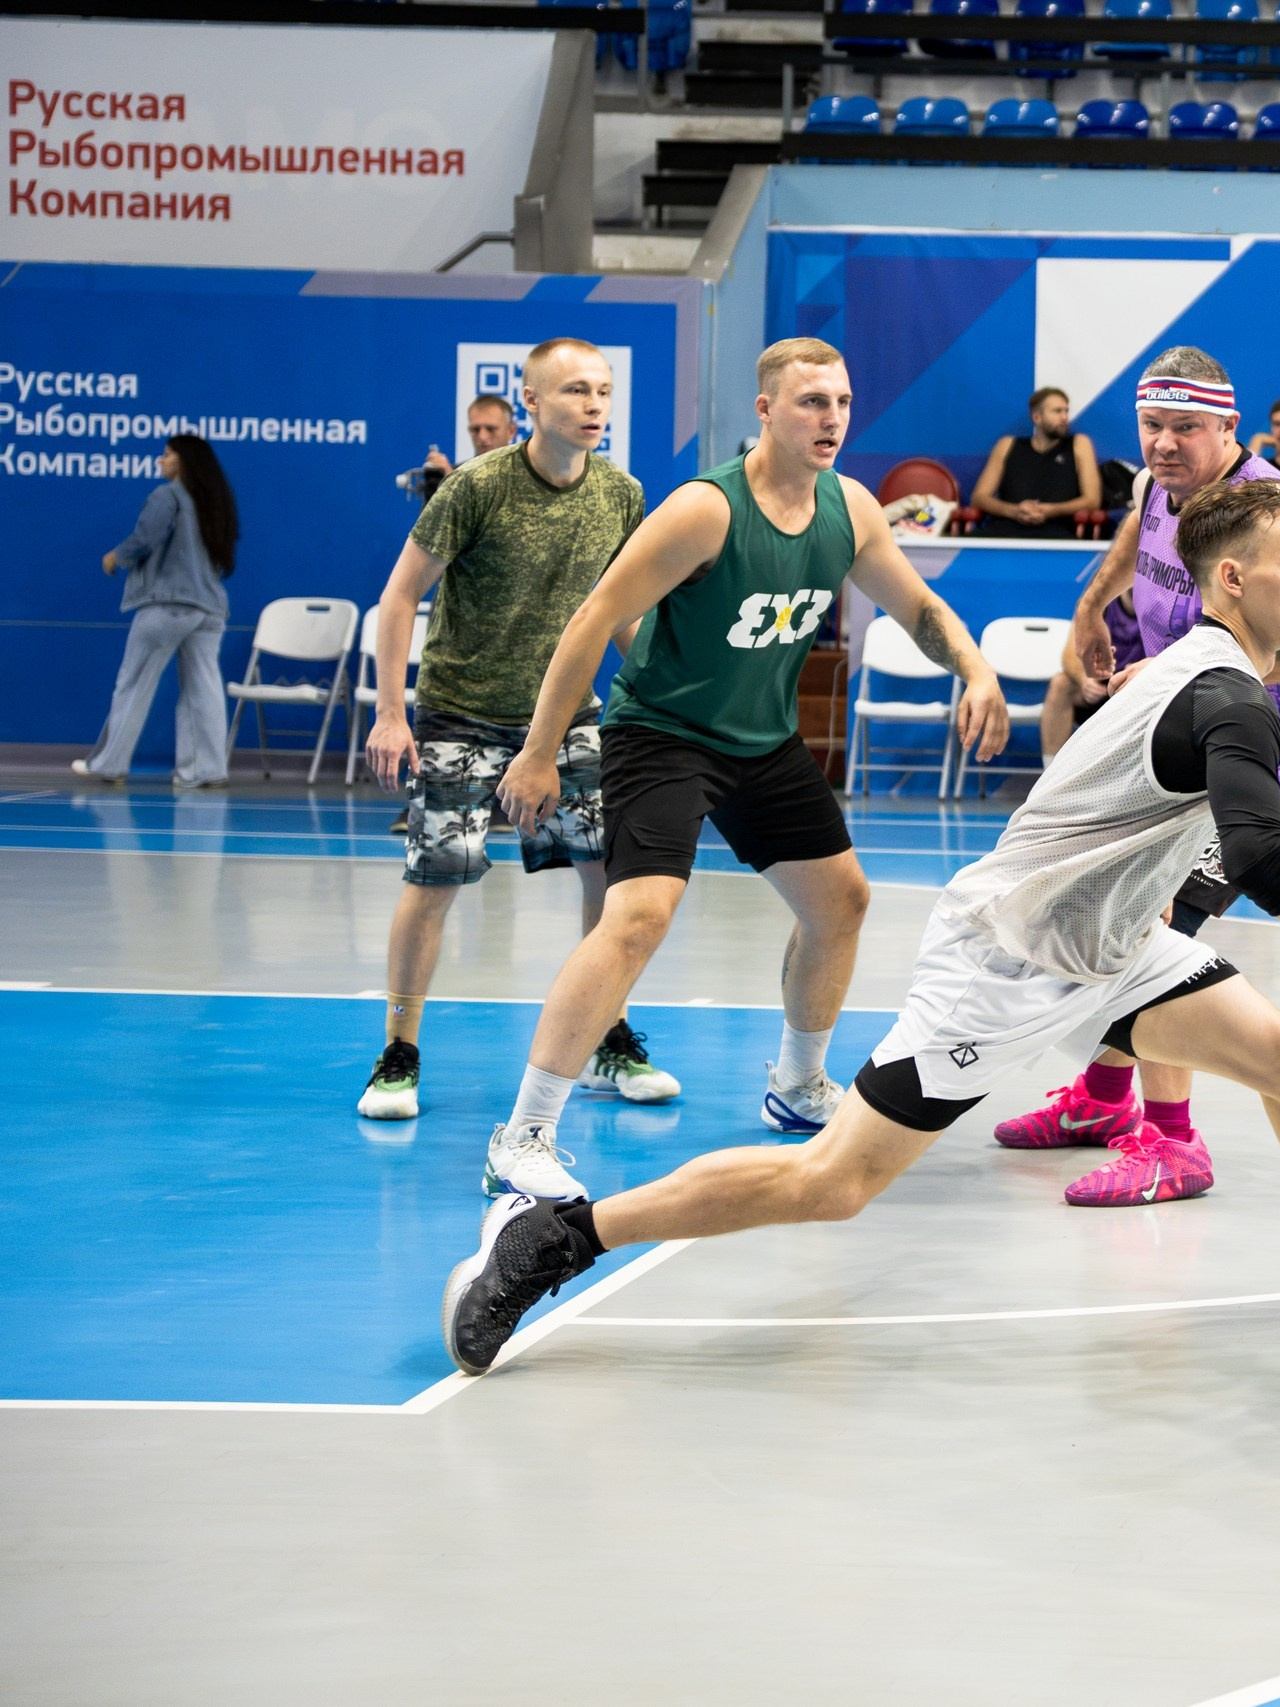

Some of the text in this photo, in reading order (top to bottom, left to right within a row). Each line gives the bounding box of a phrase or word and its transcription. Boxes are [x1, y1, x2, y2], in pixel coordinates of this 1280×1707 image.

[8, 79, 186, 126] Русская
[9, 129, 465, 180] Рыбопромышленная
[9, 178, 231, 221] Компания
[0, 362, 138, 402] Русская
[0, 403, 367, 445] Рыбопромышленная
